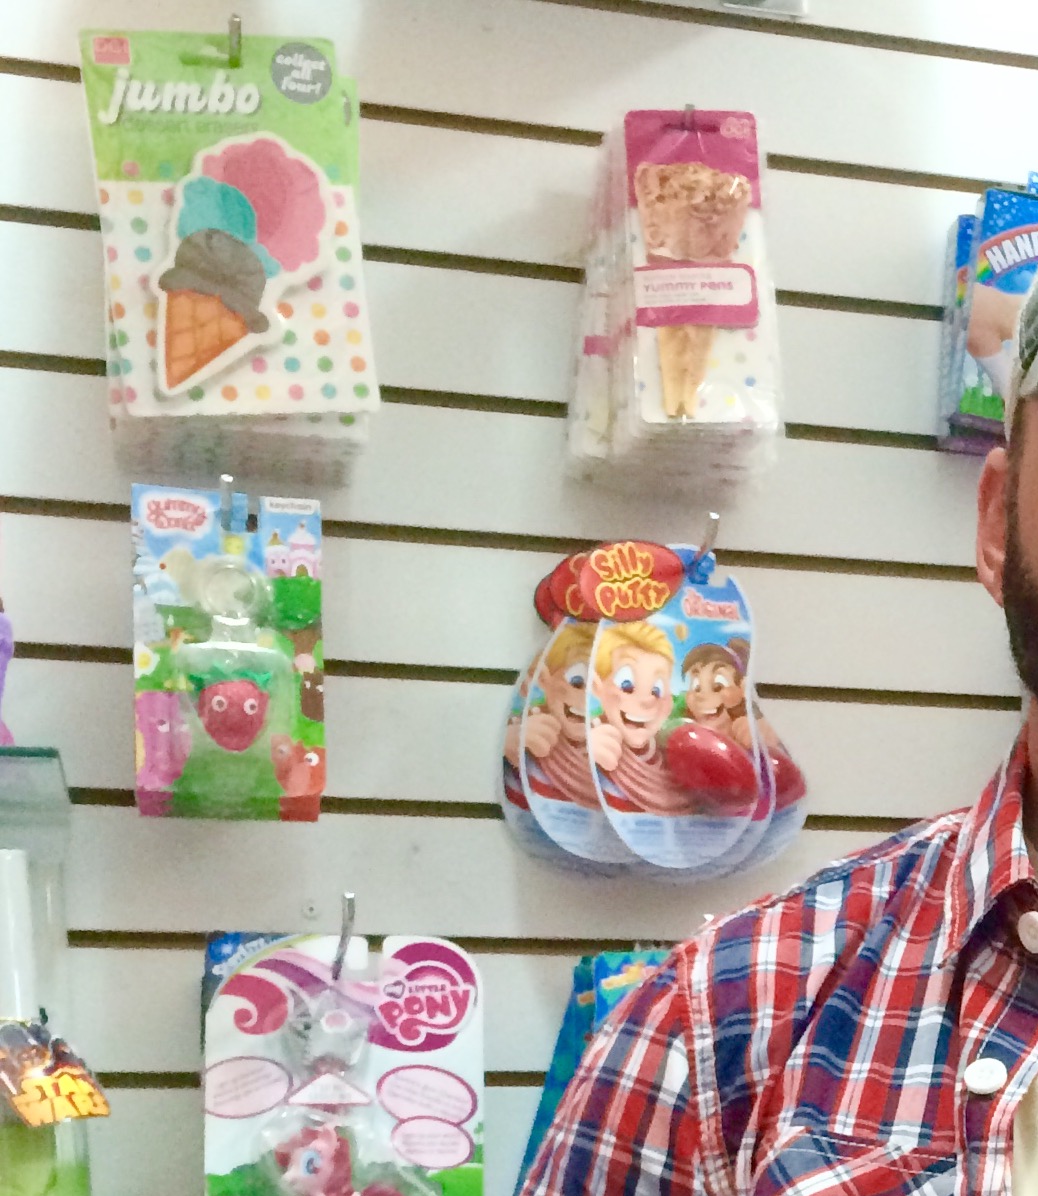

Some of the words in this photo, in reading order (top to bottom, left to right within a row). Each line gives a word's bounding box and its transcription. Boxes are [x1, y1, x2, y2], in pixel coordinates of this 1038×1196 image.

[98, 68, 261, 125] jumbo
[378, 990, 471, 1041] PONY
[12, 1073, 96, 1105] STAR
[17, 1094, 110, 1127] WARS
